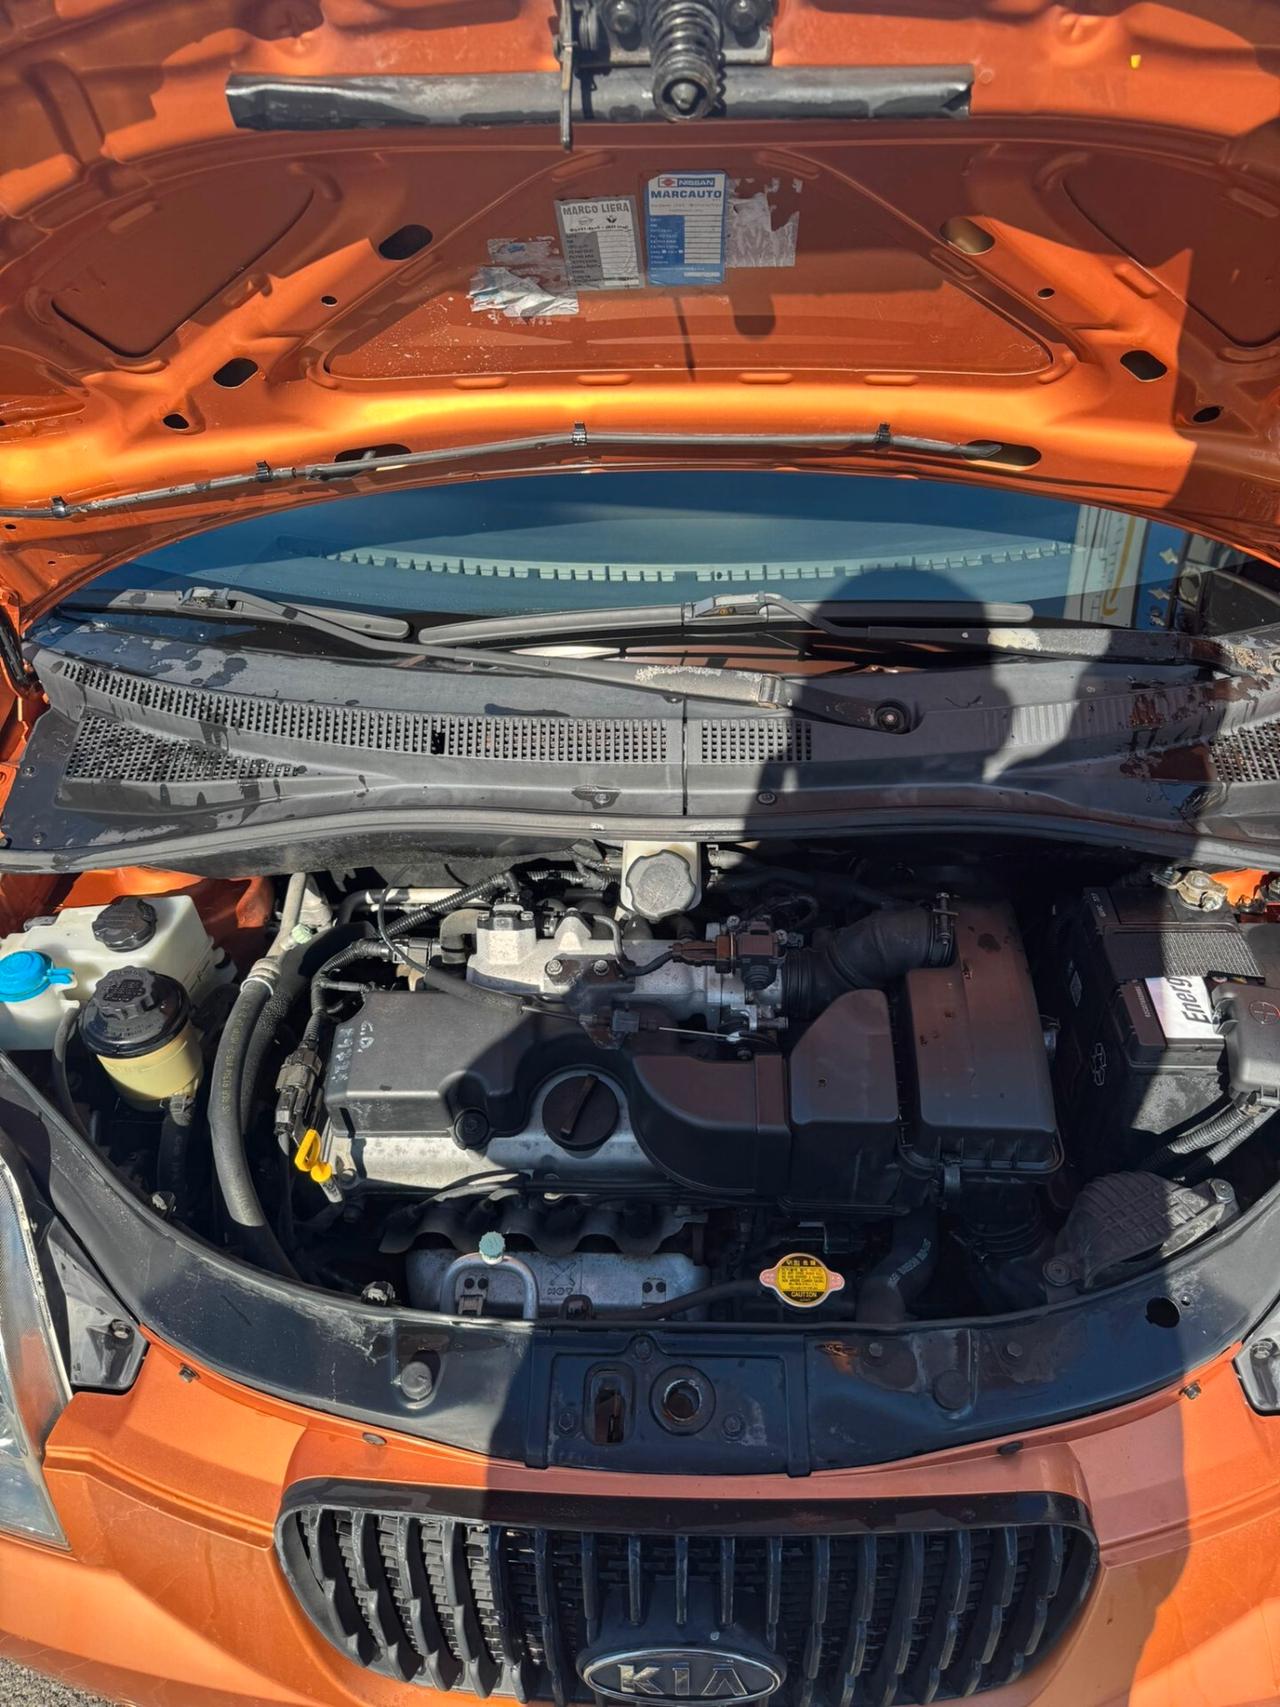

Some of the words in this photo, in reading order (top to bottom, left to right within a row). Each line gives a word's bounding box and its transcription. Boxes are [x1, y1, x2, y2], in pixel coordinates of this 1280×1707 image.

[678, 178, 714, 187] NISSAN
[650, 190, 722, 199] MARCAUTO
[562, 205, 599, 216] MARCO
[601, 202, 630, 213] LIERA
[617, 1664, 748, 1696] KIA
